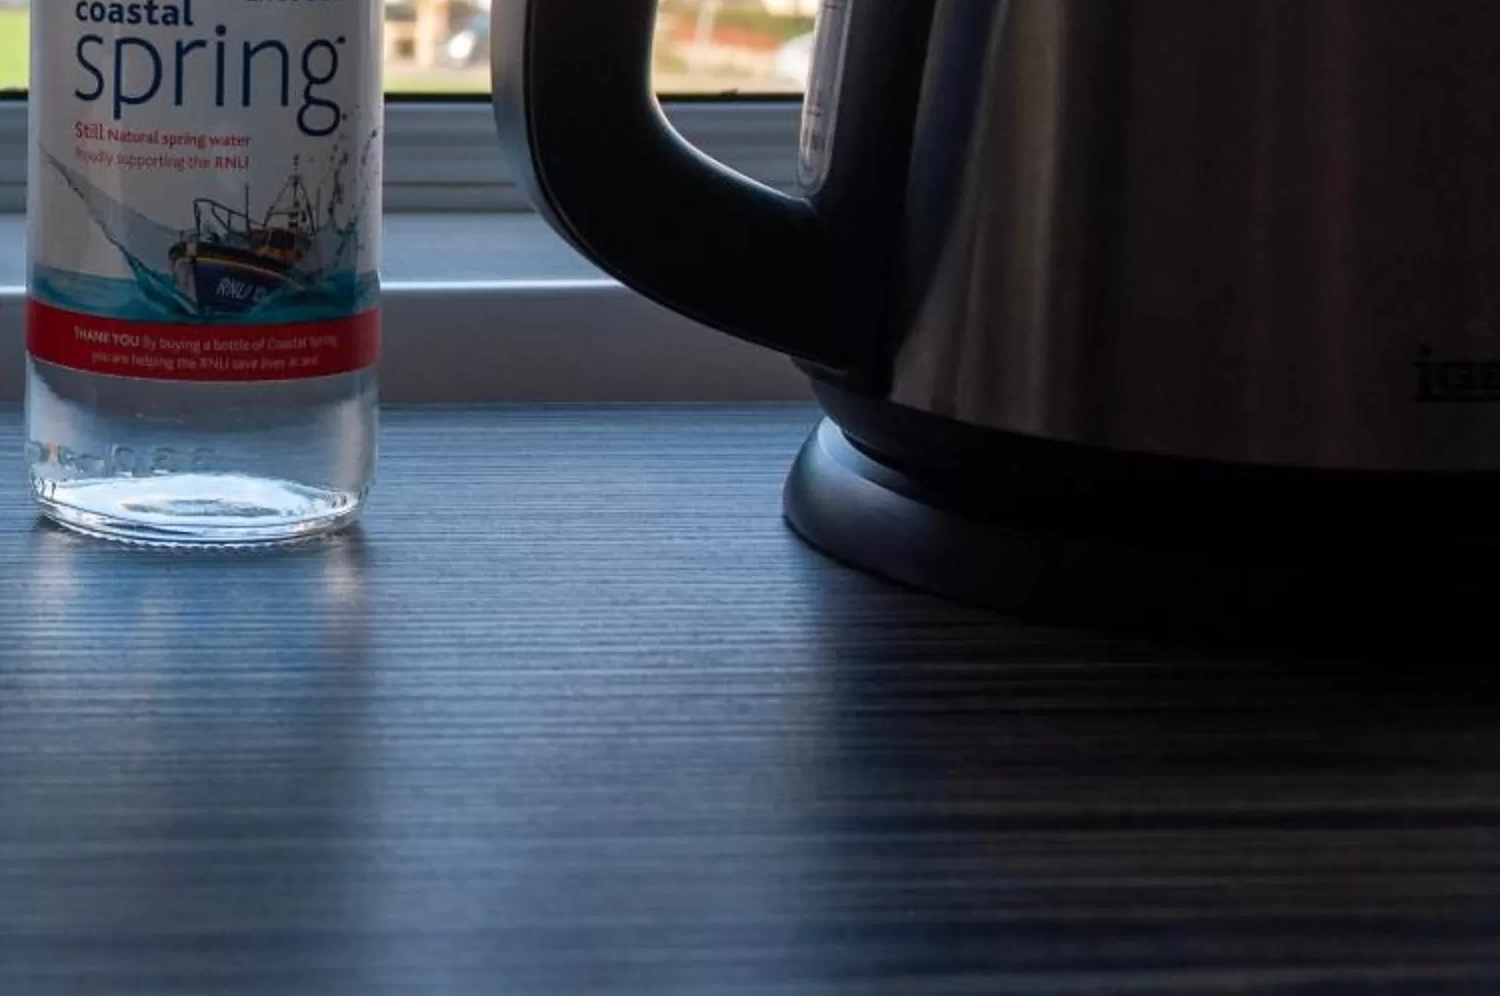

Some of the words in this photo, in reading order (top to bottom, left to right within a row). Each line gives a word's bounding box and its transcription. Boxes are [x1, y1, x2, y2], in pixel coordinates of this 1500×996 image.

[73, 24, 343, 136] spring
[75, 121, 104, 142] Still
[108, 128, 160, 144] Natural
[163, 131, 207, 150] spring
[209, 134, 252, 149] water
[214, 155, 249, 170] RNLI
